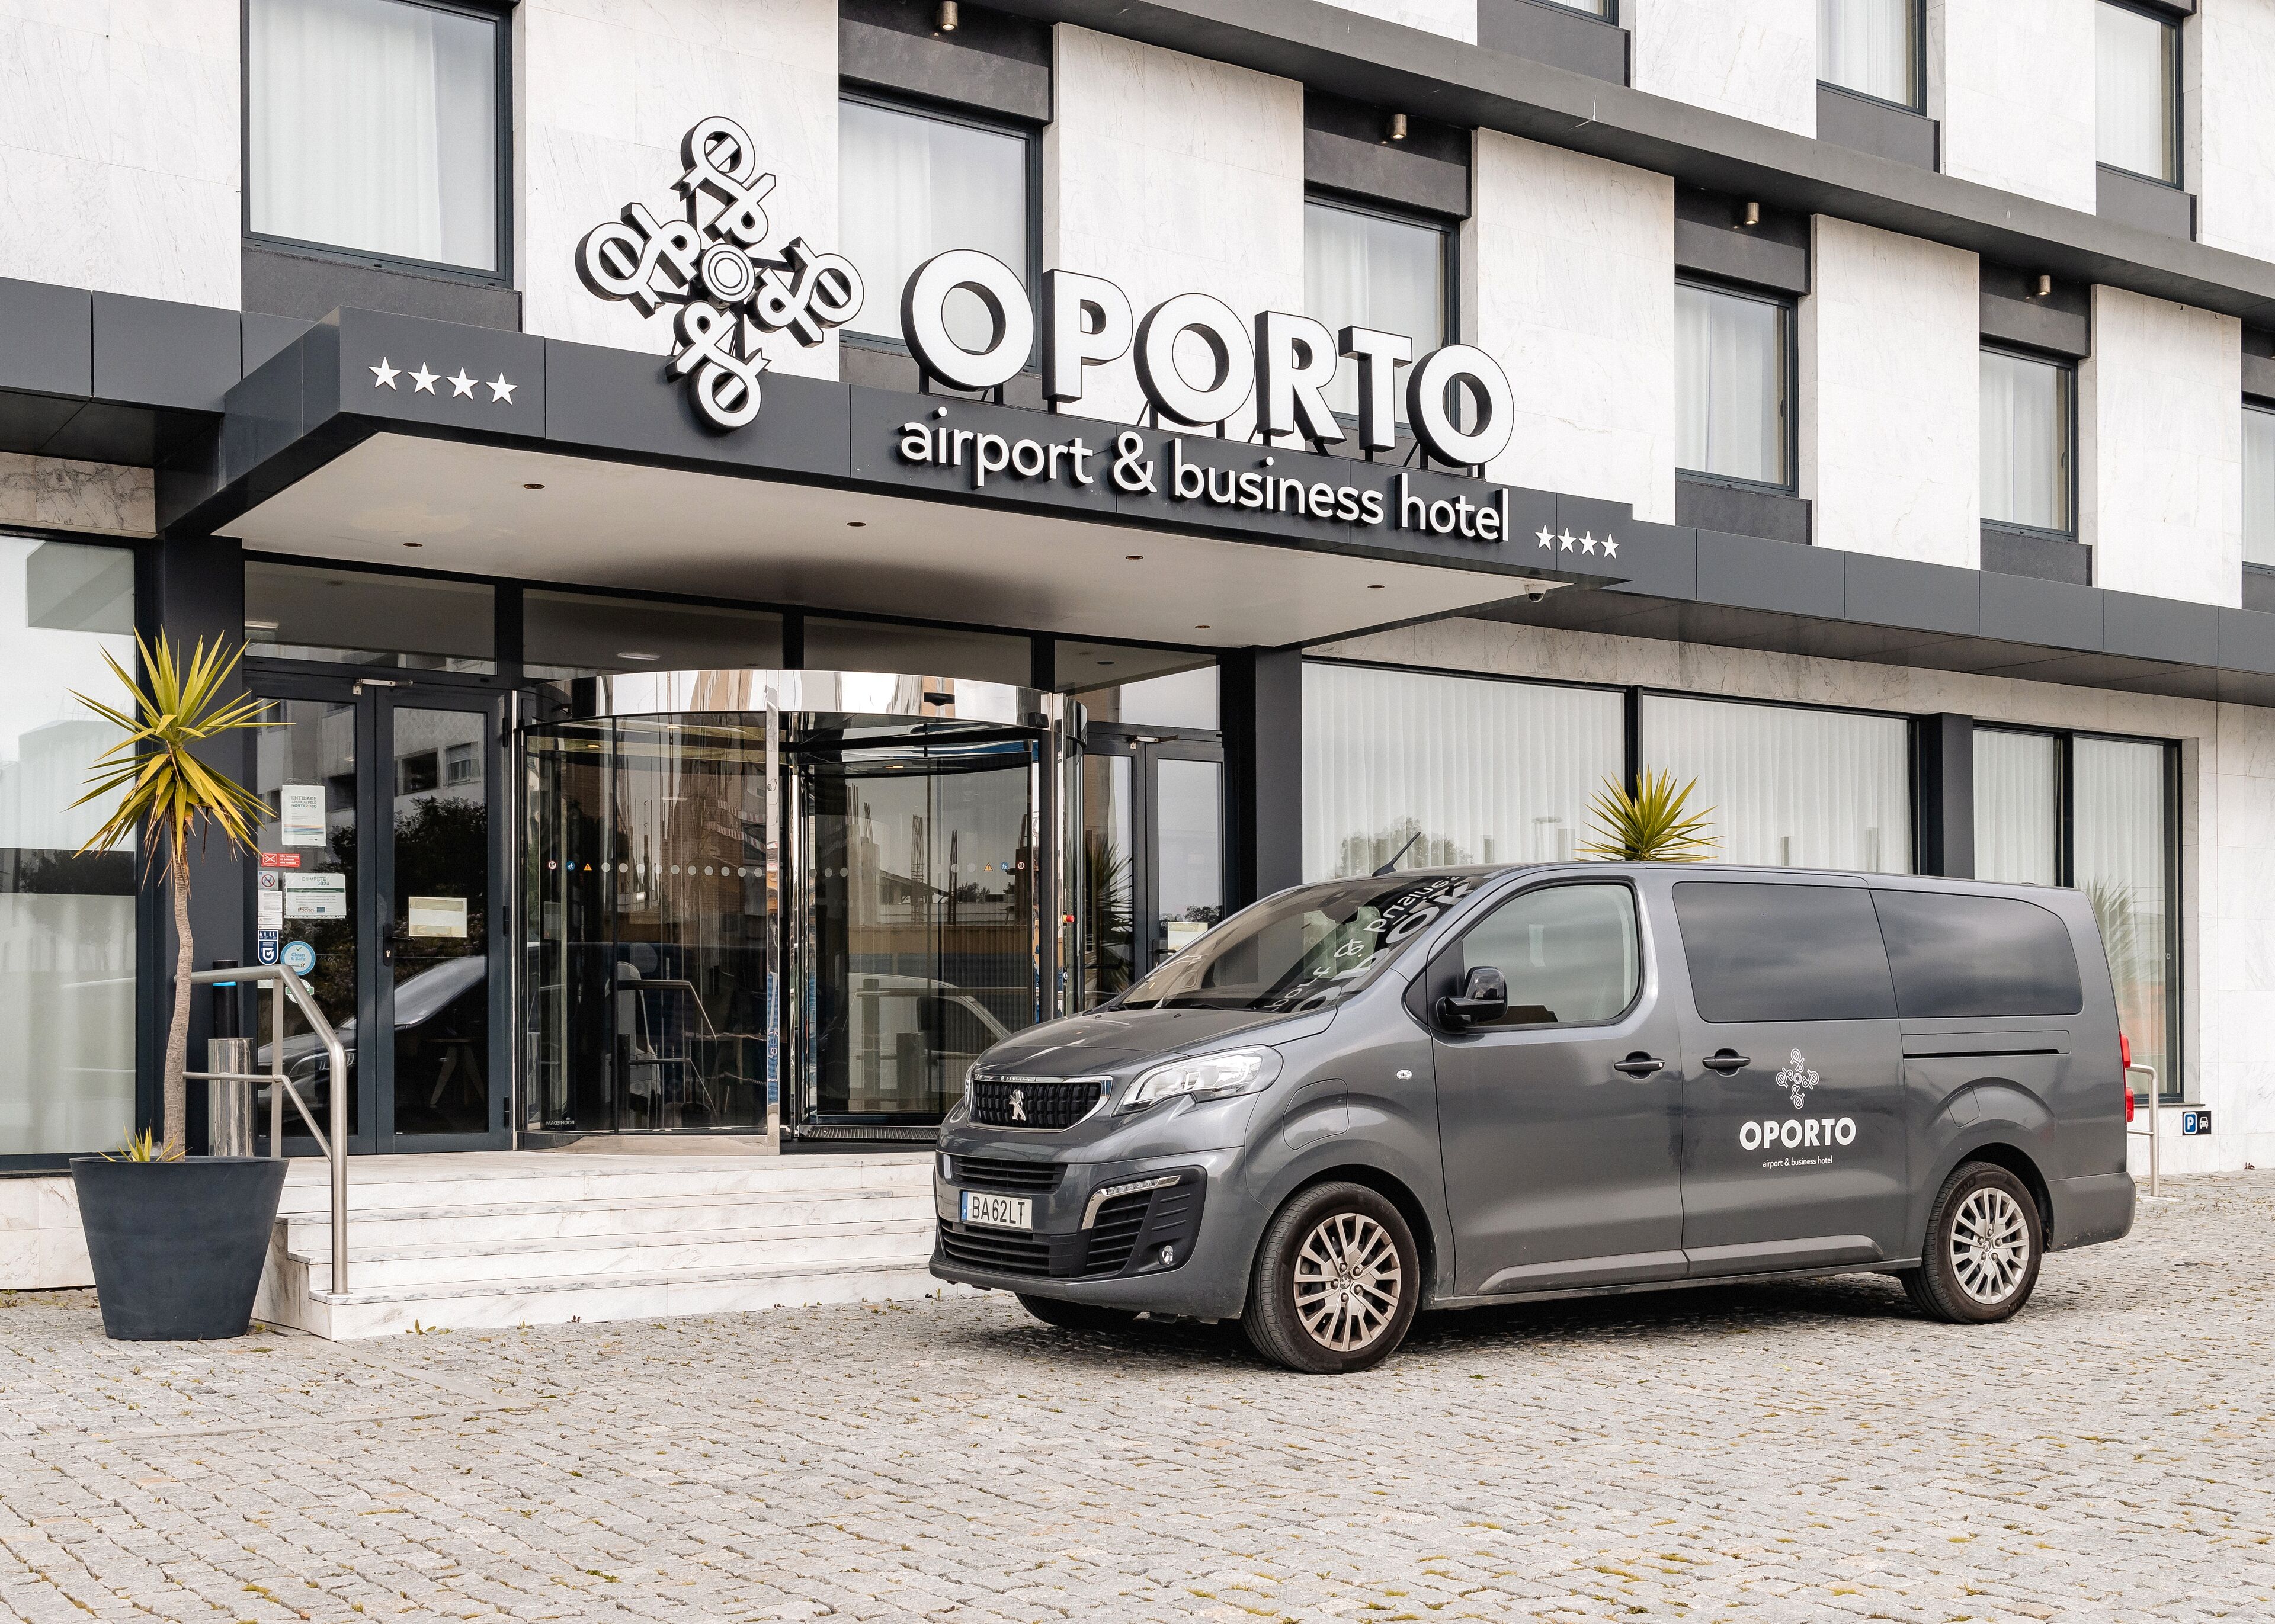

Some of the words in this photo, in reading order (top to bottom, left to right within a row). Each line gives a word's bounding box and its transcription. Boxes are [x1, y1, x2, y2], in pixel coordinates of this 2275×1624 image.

[900, 249, 1514, 468] OPORTO
[899, 407, 1094, 488] airport
[1114, 431, 1157, 493] &
[1168, 439, 1383, 525] business
[1395, 473, 1509, 541] hotel
[1739, 1117, 1856, 1150] OPORTO
[2187, 1116, 2194, 1130] P
[1763, 1159, 1783, 1169] airport
[1791, 1157, 1816, 1166] business
[1818, 1155, 1832, 1164] hotel
[972, 1196, 1025, 1225] BA62LT
